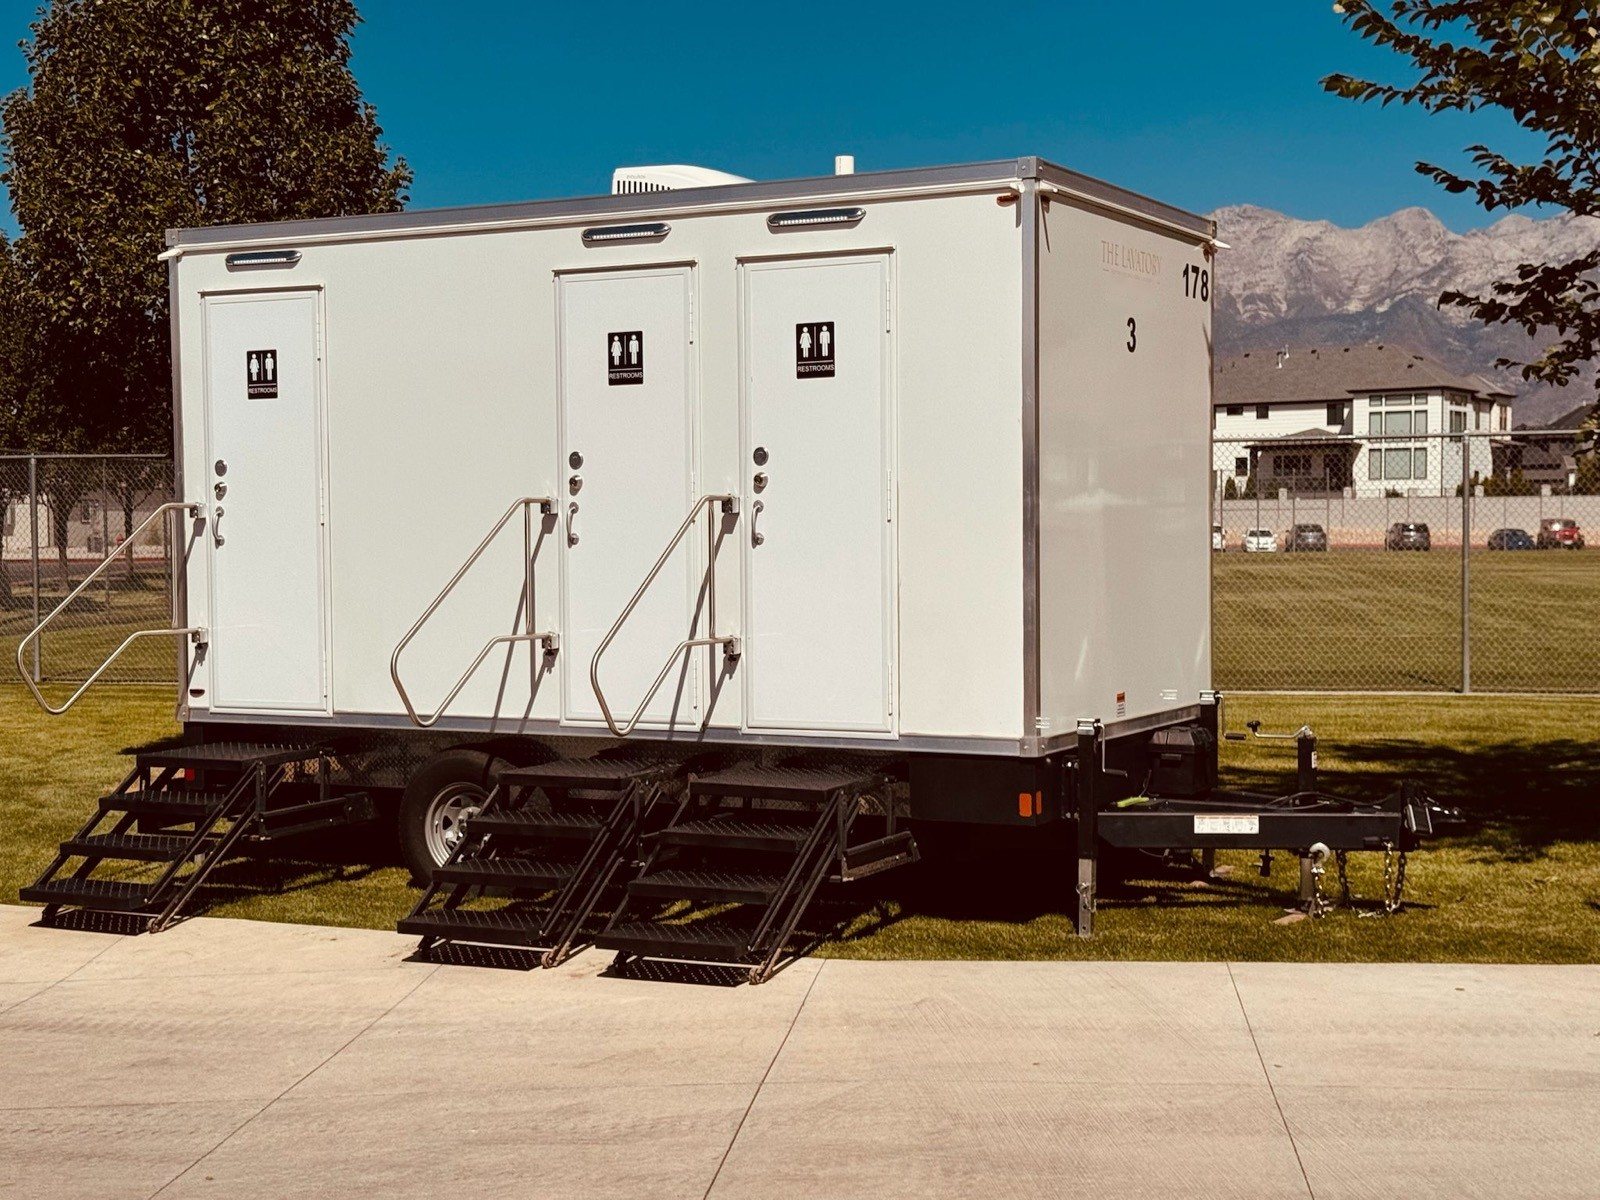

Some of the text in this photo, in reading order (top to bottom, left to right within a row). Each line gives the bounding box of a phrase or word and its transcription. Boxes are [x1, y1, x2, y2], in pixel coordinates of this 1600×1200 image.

[1101, 240, 1119, 266] THE
[1183, 263, 1209, 302] 178
[1126, 317, 1137, 353] 3
[609, 371, 643, 380] RESTROOMS
[798, 364, 835, 373] RESTROOMS
[248, 386, 278, 394] RESTROOMS
